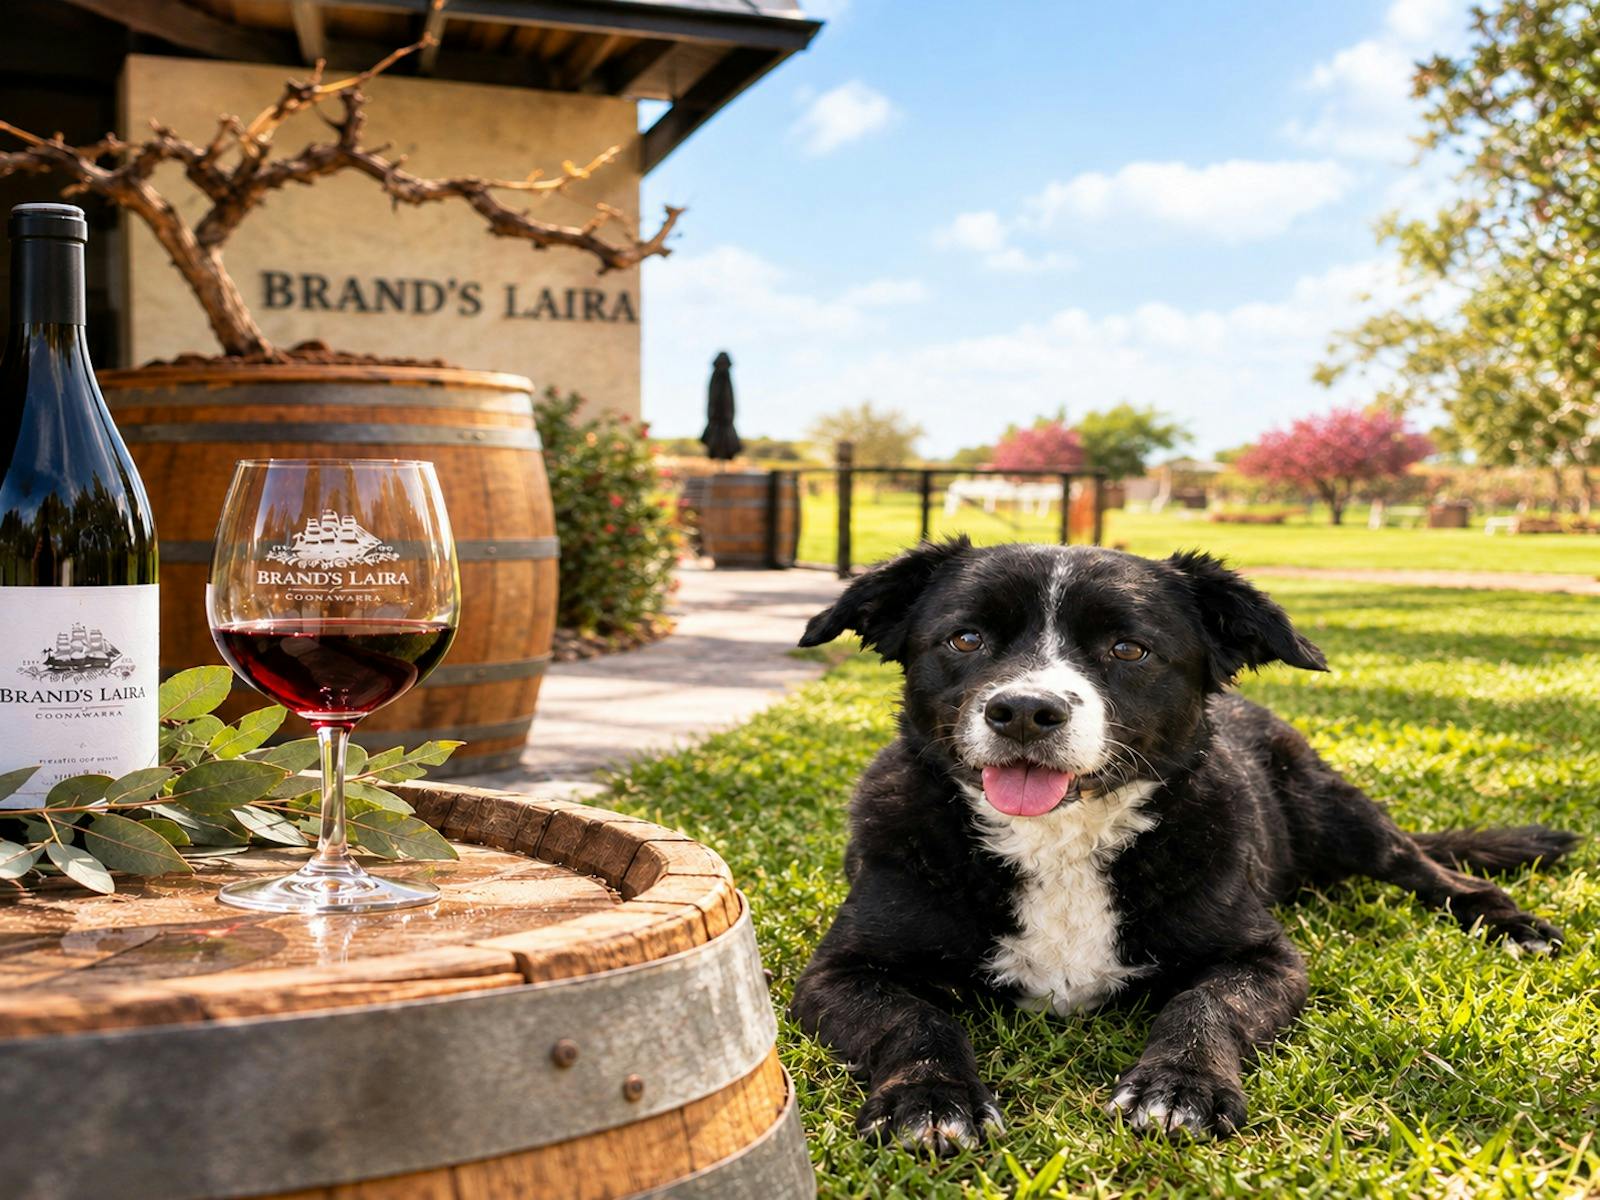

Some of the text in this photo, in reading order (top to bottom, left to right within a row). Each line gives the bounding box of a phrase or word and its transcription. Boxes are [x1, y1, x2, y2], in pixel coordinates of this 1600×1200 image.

[260, 270, 639, 323] BRAND'S LAIRA
[257, 570, 410, 586] BRAND'S LAIRA
[285, 592, 381, 602] COONAWARRA
[0, 686, 146, 704] BRAND'S LAIRA
